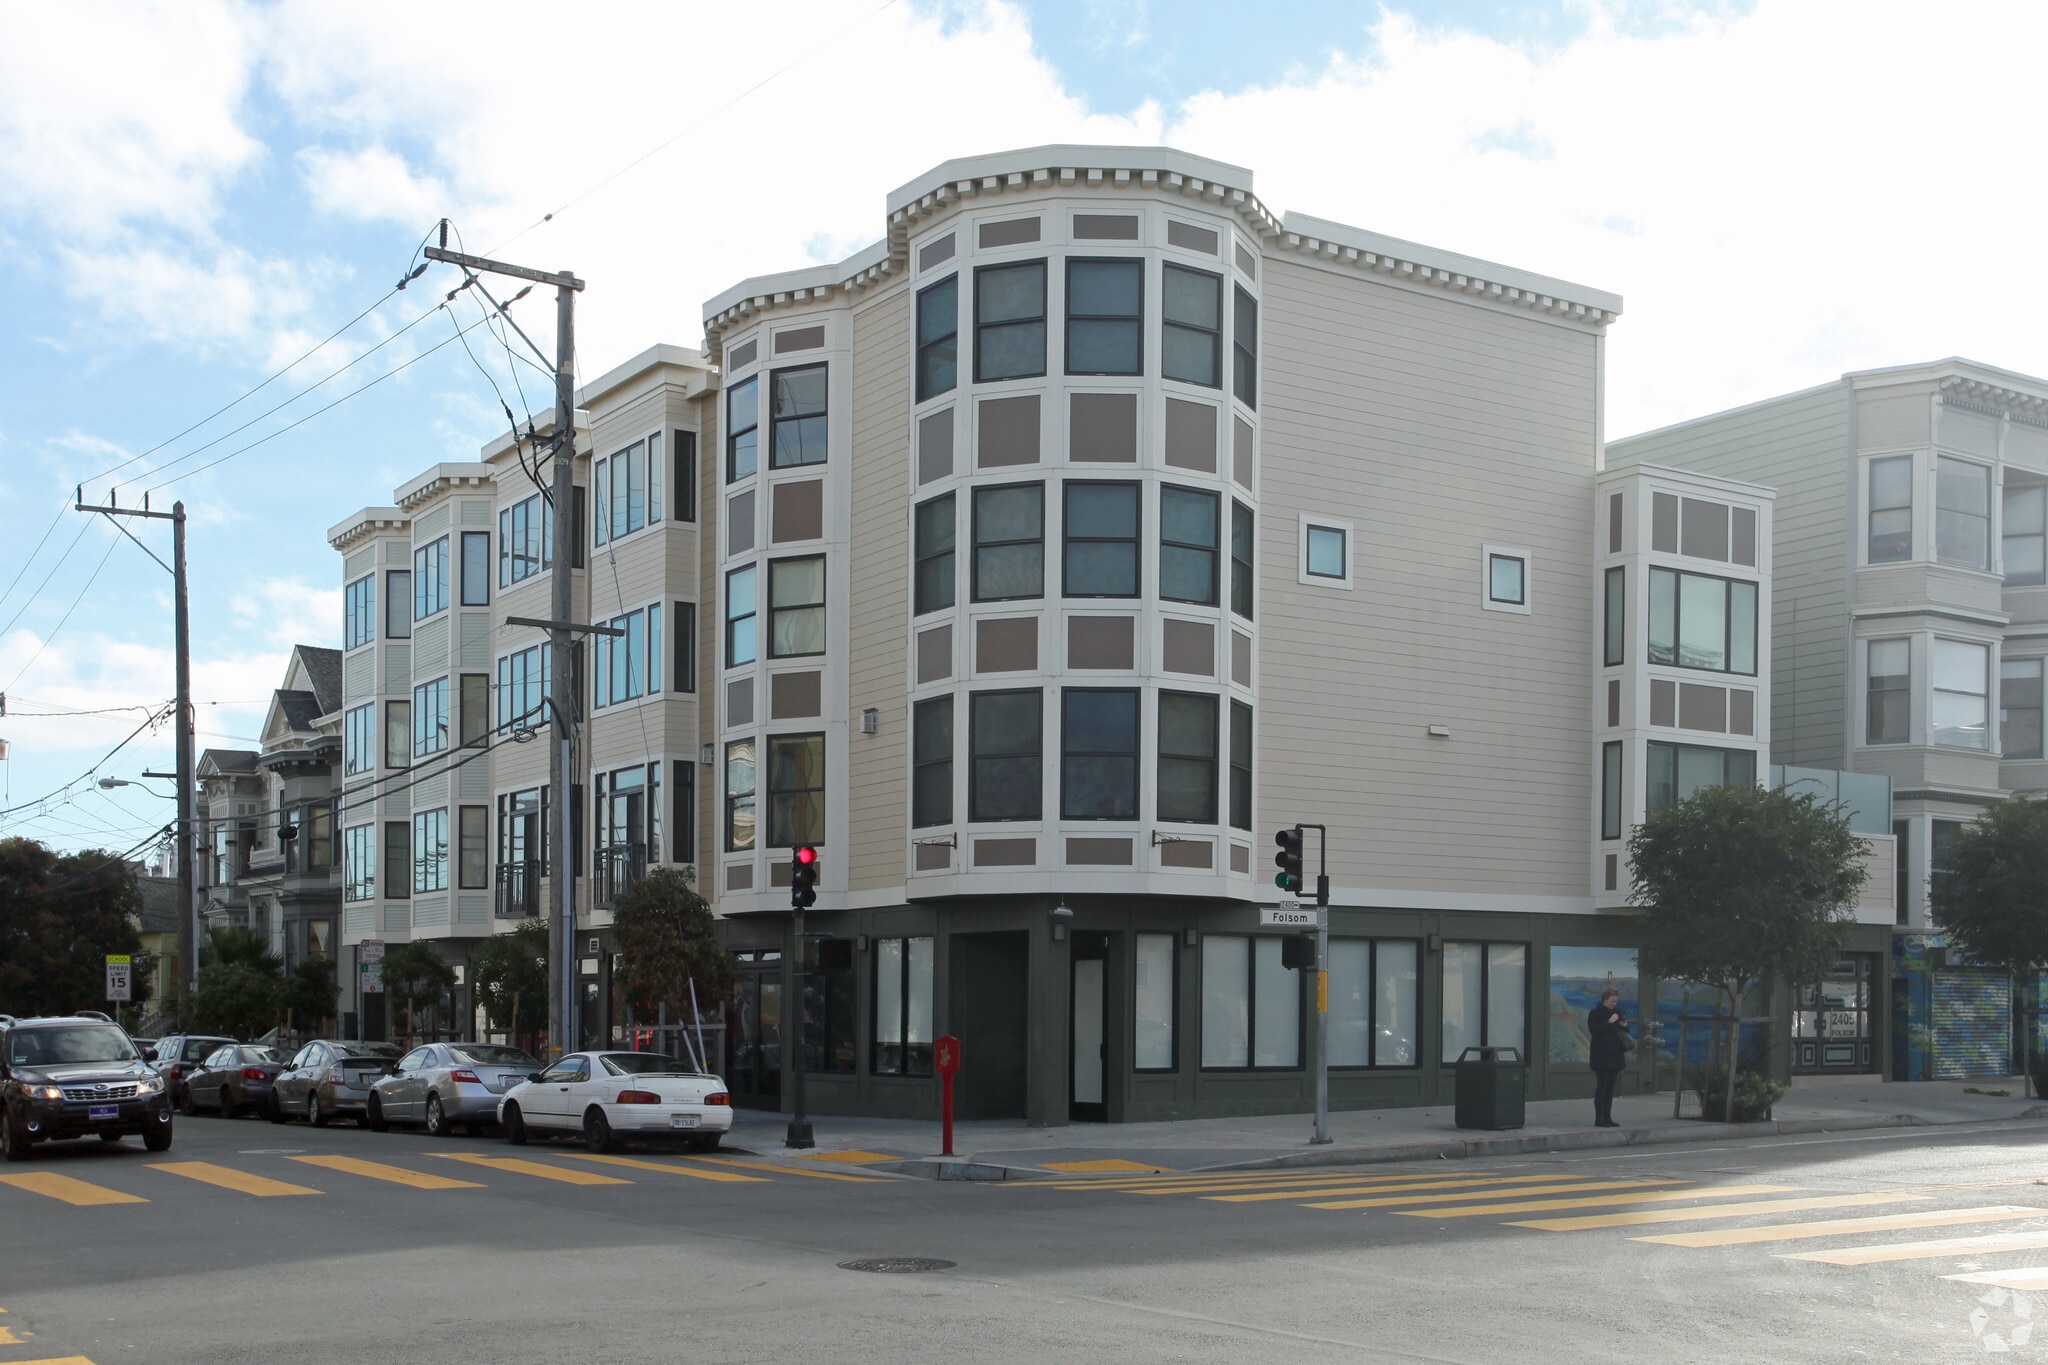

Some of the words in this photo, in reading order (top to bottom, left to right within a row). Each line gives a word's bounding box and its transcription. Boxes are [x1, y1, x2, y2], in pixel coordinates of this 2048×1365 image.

[1273, 912, 1308, 923] Folsom
[111, 977, 127, 988] 15
[1832, 1013, 1855, 1025] 2405
[1832, 1029, 1855, 1037] FOLSOM
